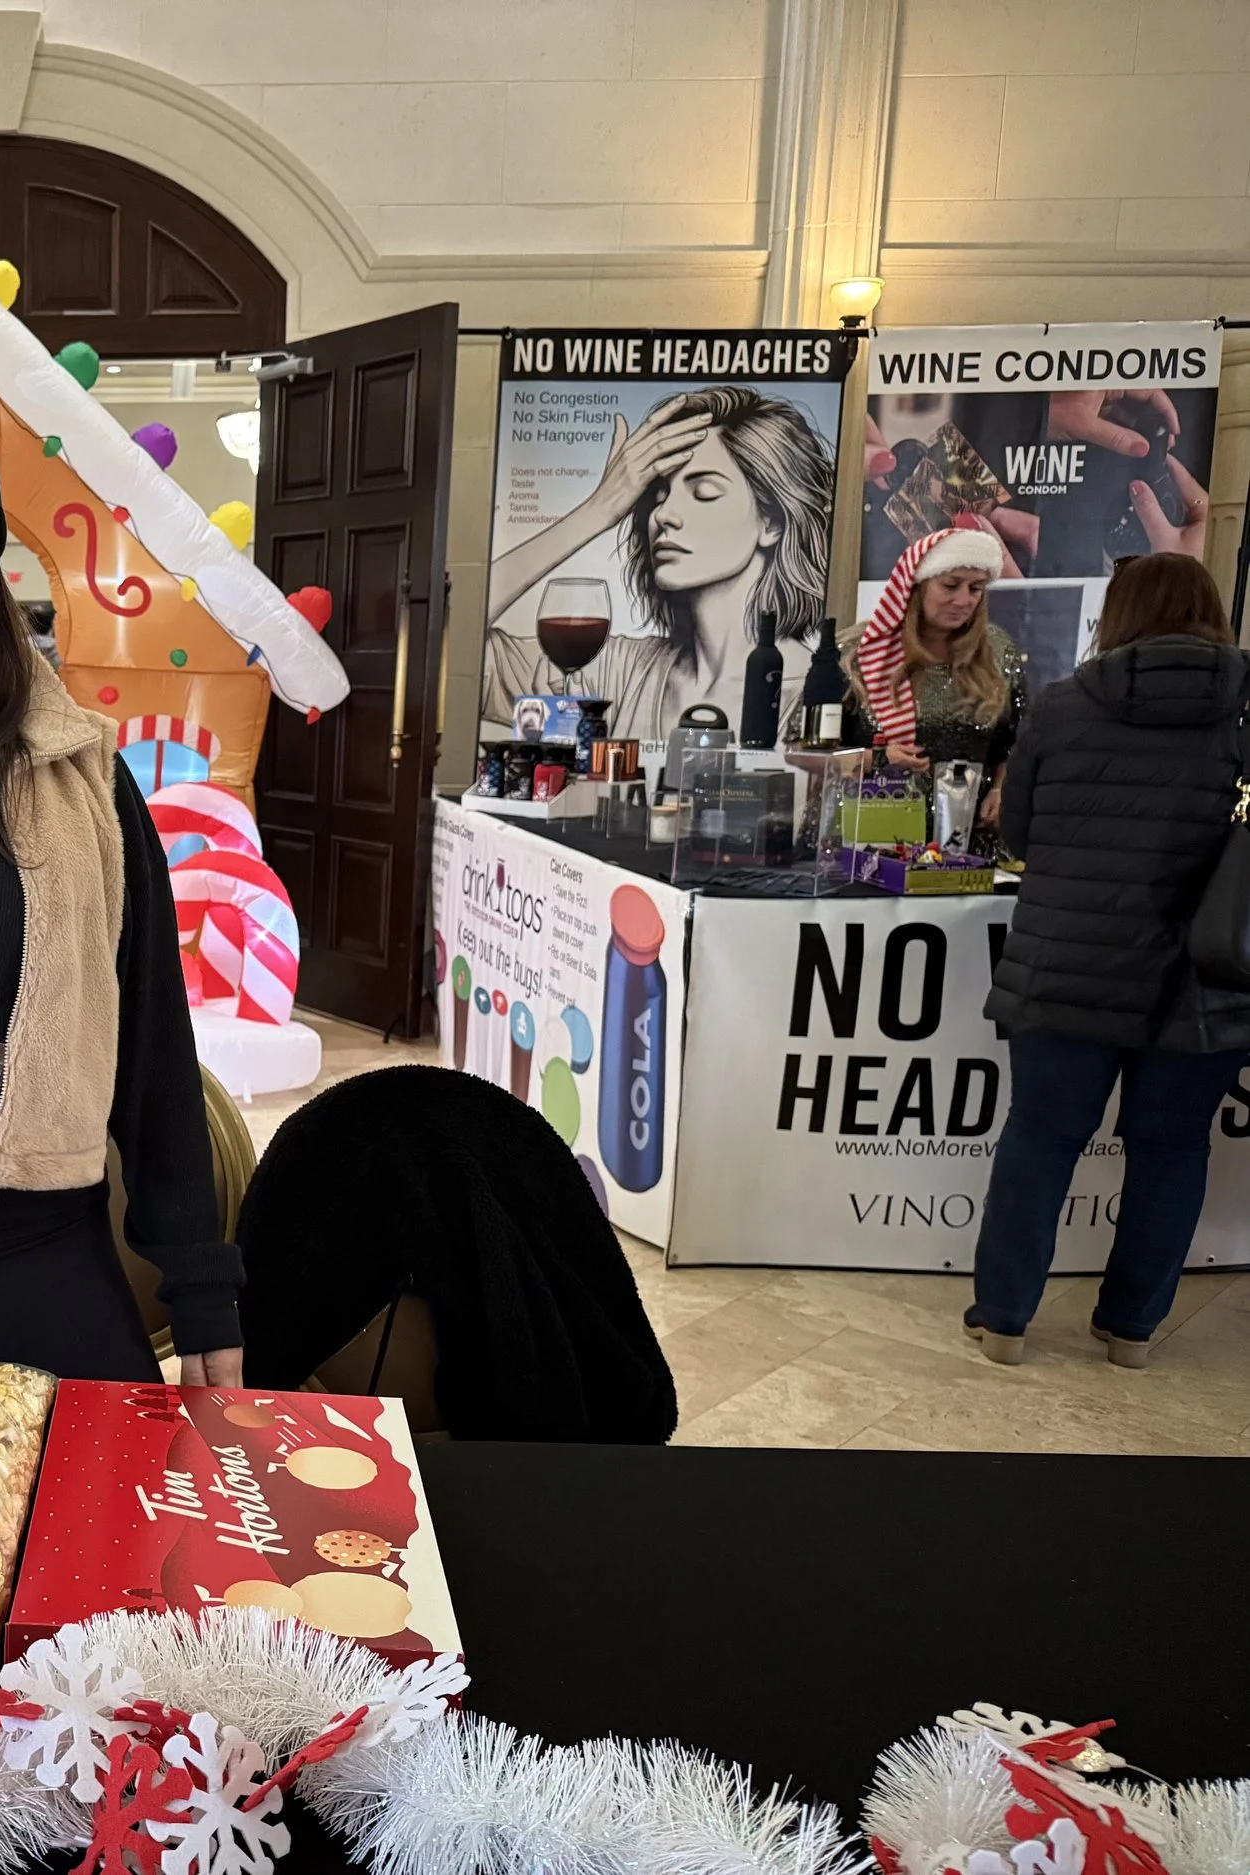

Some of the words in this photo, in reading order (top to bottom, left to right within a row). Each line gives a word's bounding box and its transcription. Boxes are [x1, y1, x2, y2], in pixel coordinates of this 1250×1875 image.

[513, 338, 554, 373] NO
[563, 338, 643, 374] WINE
[652, 338, 832, 375] HEADACHES
[879, 351, 982, 385] WINE
[995, 347, 1207, 383] CONDOMS
[513, 391, 535, 405] No
[539, 391, 619, 407] Congestion
[513, 410, 534, 424] No
[538, 410, 569, 424] Skin
[573, 410, 612, 424] Flush
[511, 429, 532, 442] No
[536, 429, 605, 446] Hangover
[510, 467, 535, 477] Does
[538, 467, 553, 477] not
[1004, 444, 1087, 485] WINE
[508, 491, 539, 500] Aroma
[510, 480, 535, 489] Taste
[1017, 484, 1067, 496] CONDOM
[550, 858, 561, 875] Can
[562, 863, 583, 884] Covers
[462, 854, 496, 910] drink
[505, 874, 545, 940] tops
[458, 919, 477, 961] Keep
[479, 939, 493, 967] out
[496, 941, 511, 977] the
[514, 951, 543, 999] bugs!
[789, 922, 948, 1041] NO
[629, 1007, 652, 1151] COLA
[134, 1468, 209, 1521] Tim
[207, 1444, 291, 1555] Hortons
